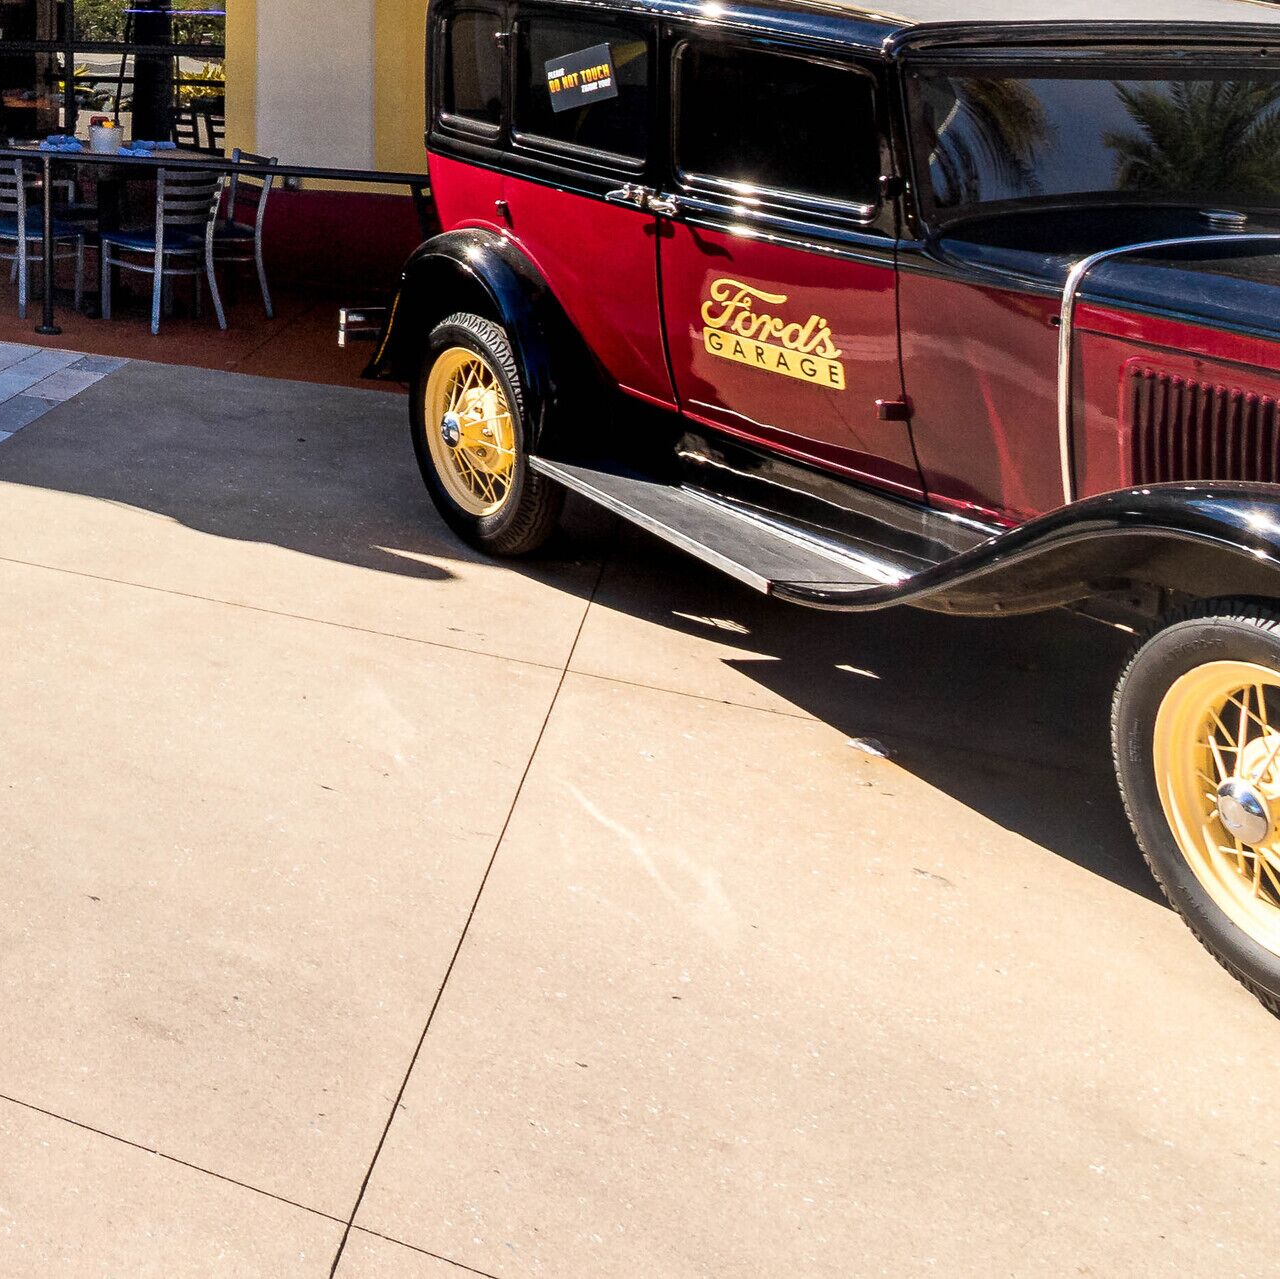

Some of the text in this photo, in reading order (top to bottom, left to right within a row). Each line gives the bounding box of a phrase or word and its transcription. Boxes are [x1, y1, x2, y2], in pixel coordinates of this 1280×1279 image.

[549, 64, 610, 93] DO NOT TOUCH
[700, 278, 843, 360] Ford's
[708, 332, 840, 384] GARAGE
